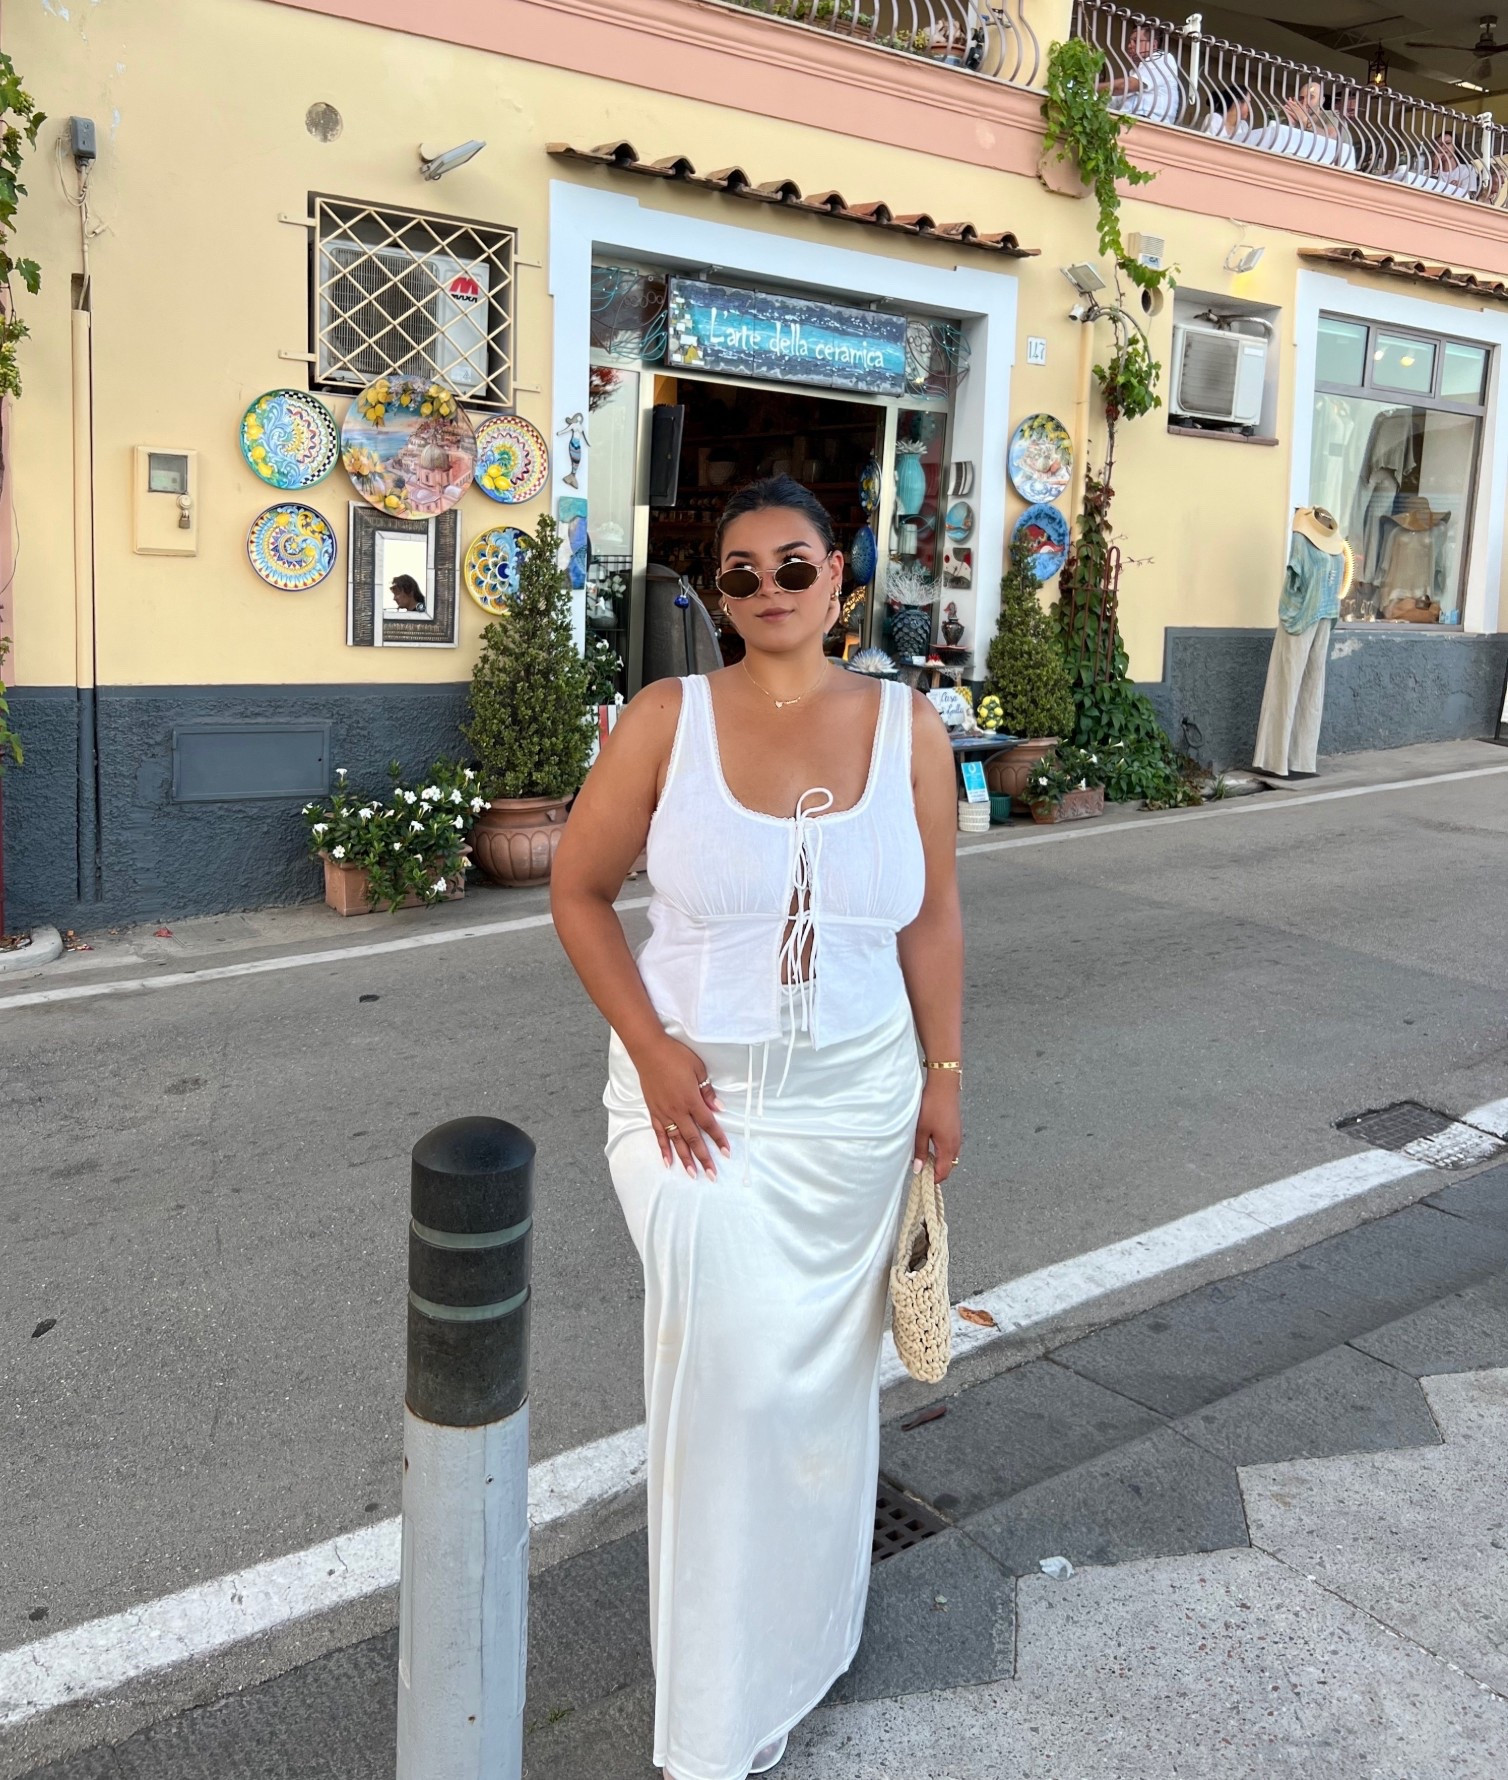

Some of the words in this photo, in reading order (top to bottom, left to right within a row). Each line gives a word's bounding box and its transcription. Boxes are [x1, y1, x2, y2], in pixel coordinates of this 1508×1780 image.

[710, 307, 761, 350] L'arte
[769, 321, 808, 357] della
[815, 341, 885, 368] ceramica
[1029, 341, 1045, 360] 147
